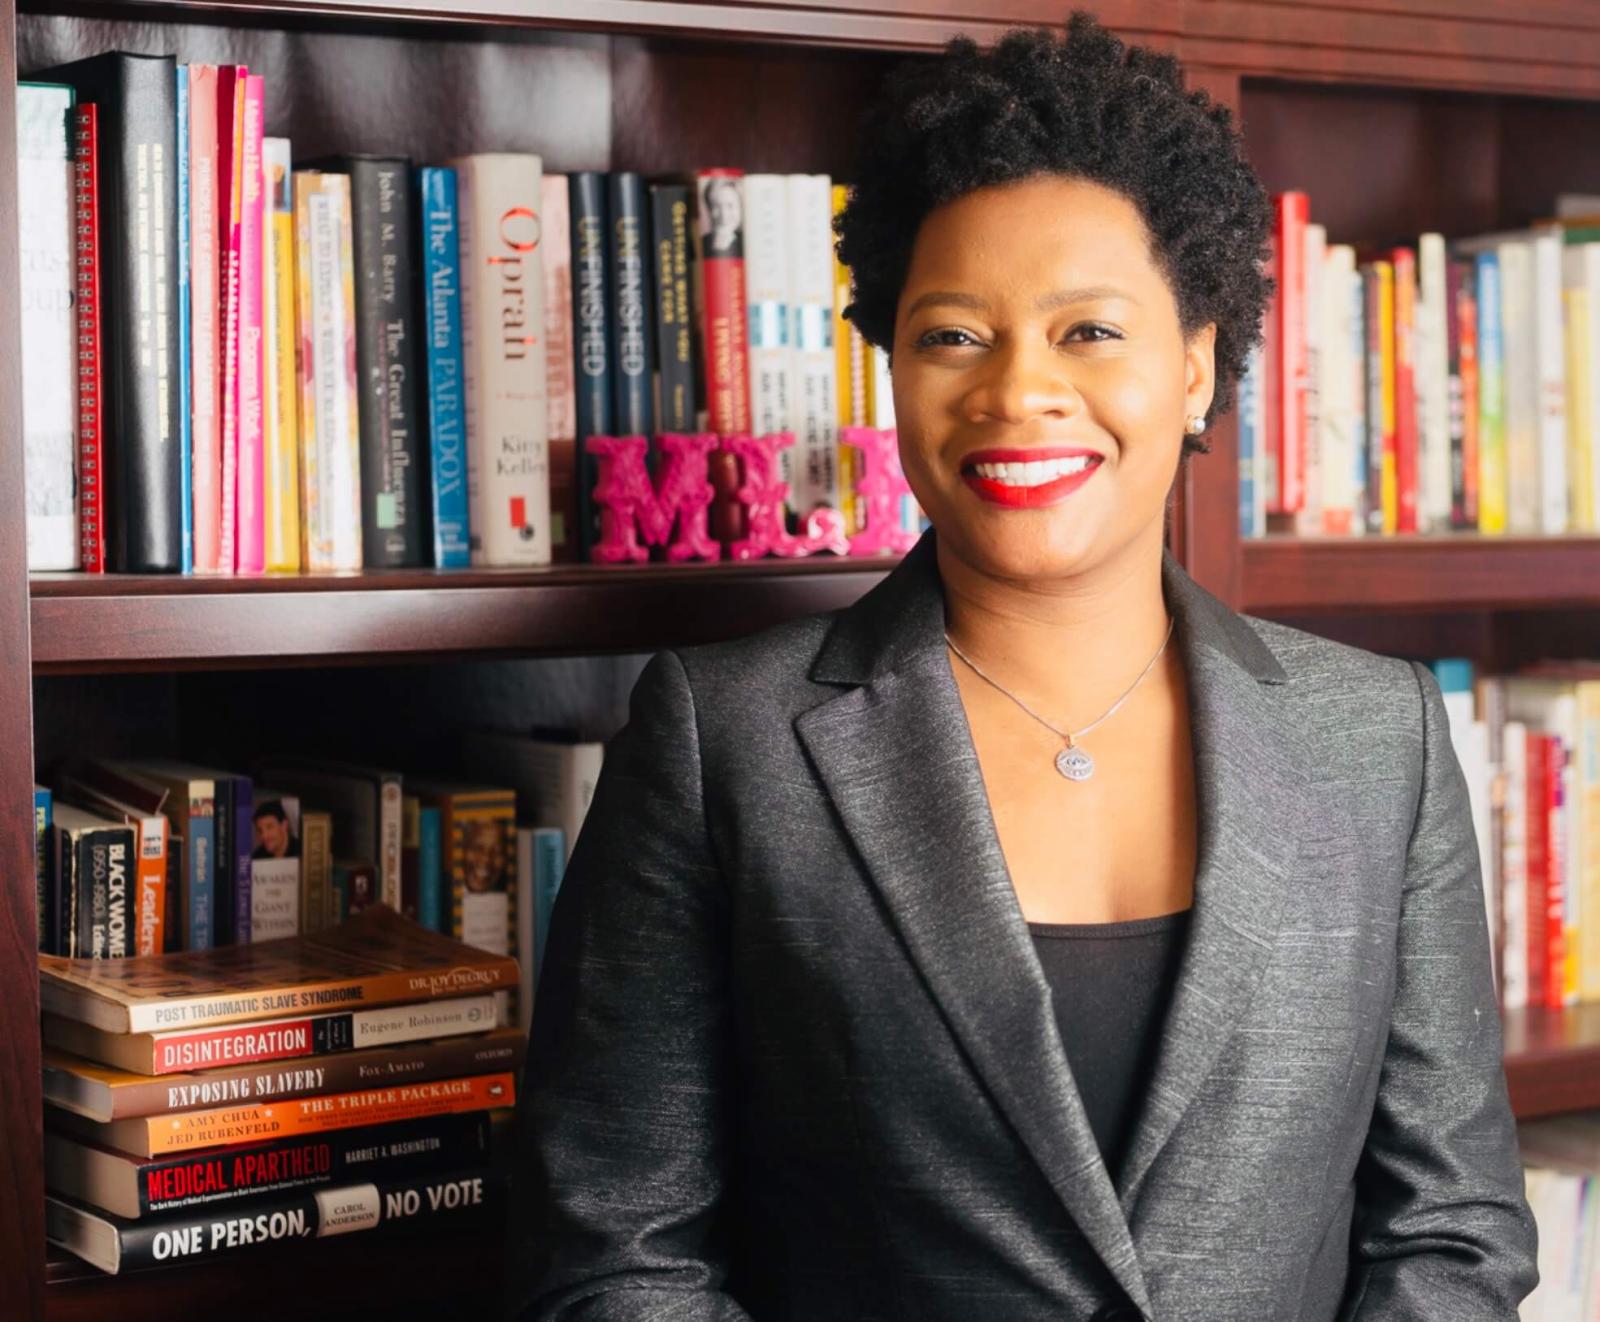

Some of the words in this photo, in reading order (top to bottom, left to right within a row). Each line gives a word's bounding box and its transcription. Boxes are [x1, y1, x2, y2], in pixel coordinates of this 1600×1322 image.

[377, 172, 396, 213] John
[381, 222, 396, 247] M.
[430, 206, 454, 255] The
[378, 254, 398, 303] Barry
[486, 206, 542, 360] Oprah
[431, 260, 456, 349] Atlanta
[386, 318, 405, 357] The
[388, 364, 407, 420] Great
[435, 357, 462, 498] PARADOX
[108, 843, 126, 899] BLACK
[105, 899, 125, 959] WOME
[155, 1007, 187, 1024] POST
[190, 998, 259, 1019] TRAUMATIC
[262, 992, 298, 1010] SLAVE
[301, 985, 364, 1007] SYNDROME
[360, 1021, 404, 1035] Eugene
[408, 1012, 462, 1028] Robinson
[164, 1027, 306, 1067] DISINTEGRATION
[168, 1078, 250, 1109] EXPOSING
[255, 1067, 326, 1096] SLAVERY
[300, 1099, 334, 1114] THE
[338, 1091, 397, 1109] TRIPLE
[401, 1081, 472, 1100] PACKAGE
[167, 1132, 193, 1145] JED
[200, 1121, 280, 1142] RUBENFELD
[186, 1115, 217, 1129] AMY
[222, 1109, 261, 1124] CHUA
[345, 1146, 379, 1164] HARRIET
[390, 1137, 441, 1156] WASHINGTON
[147, 1160, 228, 1201] MEDICAL
[233, 1143, 331, 1187] APARTHEID
[334, 1203, 367, 1215] CAROL
[385, 1189, 420, 1219] NO
[426, 1178, 483, 1212] VOTE
[152, 1225, 203, 1261] ONE
[210, 1208, 312, 1250] PERSON,
[326, 1212, 375, 1227] ANDERSON
